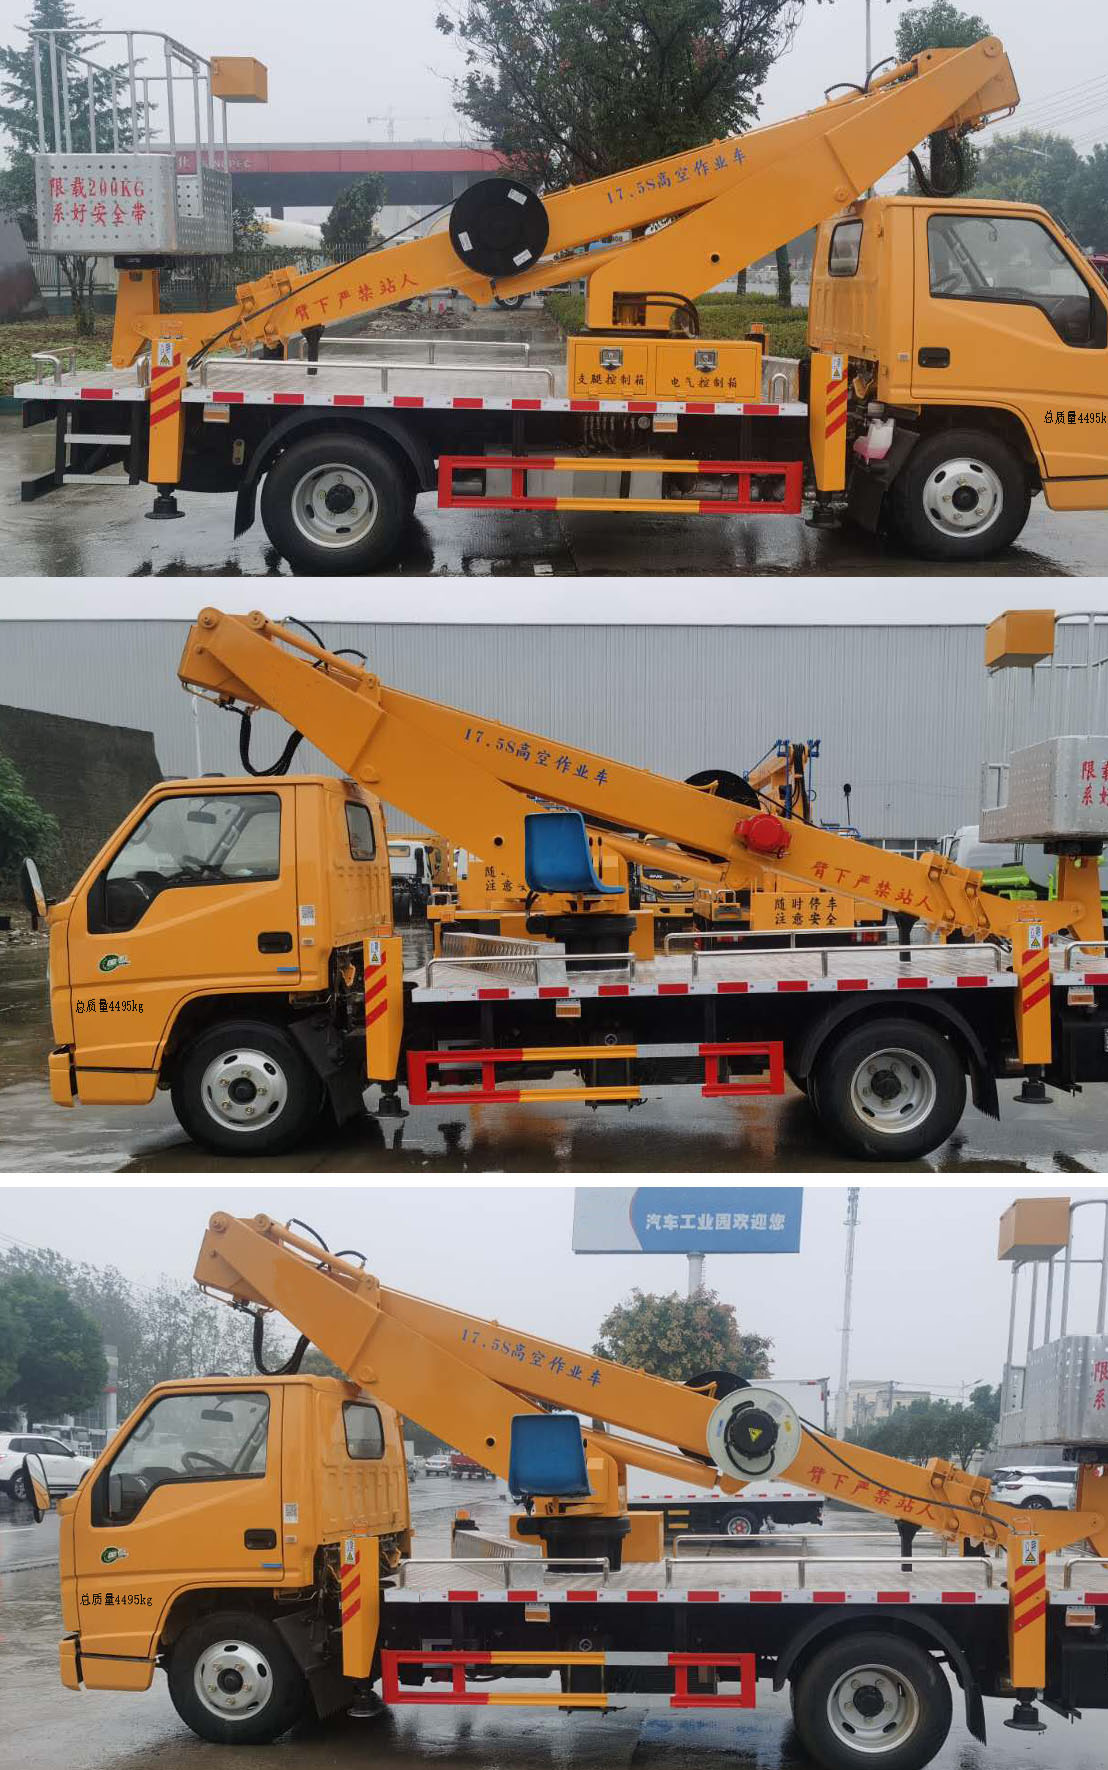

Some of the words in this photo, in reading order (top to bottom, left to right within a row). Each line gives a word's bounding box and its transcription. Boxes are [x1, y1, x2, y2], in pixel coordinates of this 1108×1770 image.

[606, 146, 748, 205] 17.5S高空作业车
[48, 177, 145, 198] 限载200KG
[52, 202, 147, 225] 系好安全带
[295, 272, 419, 321] 臂下严禁站人
[577, 373, 646, 386] 支腿控制箱
[671, 376, 737, 388] 电气控制箱
[464, 728, 609, 785] 17.5S高空作业车
[810, 861, 935, 913] 臂下严禁站人
[774, 897, 838, 911] 随时停车
[775, 912, 838, 926] 注意安全
[75, 998, 144, 1013] 总质量4495kg
[646, 1213, 786, 1231] 汽车工业园欢迎您
[461, 1329, 601, 1387] 17.5S高空作业车
[808, 1465, 935, 1520] 臂下严禁站人
[80, 1592, 153, 1607] 总质量4495kg
